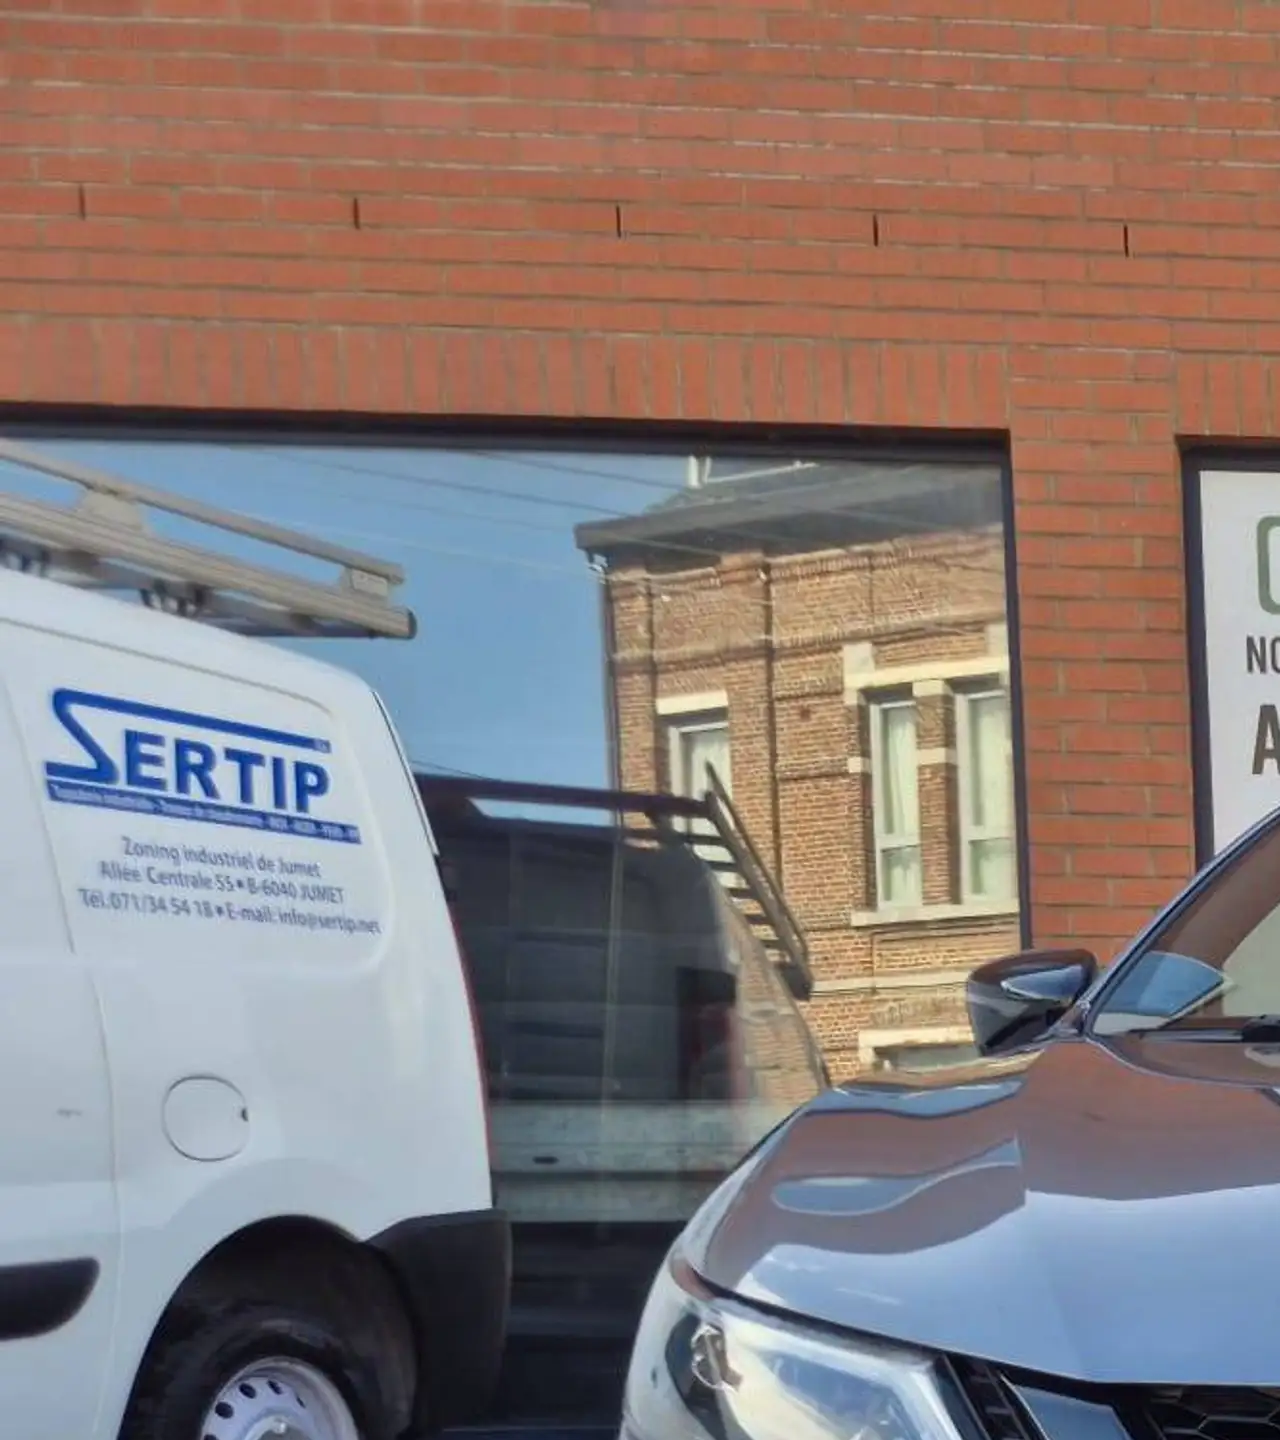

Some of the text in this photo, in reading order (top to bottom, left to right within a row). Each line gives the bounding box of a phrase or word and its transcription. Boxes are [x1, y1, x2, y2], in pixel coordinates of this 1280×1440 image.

[46, 688, 331, 813] SERTIP
[122, 836, 180, 866] Zoning
[182, 844, 253, 870] industriel
[257, 853, 276, 872] de
[147, 866, 213, 890] Centrale
